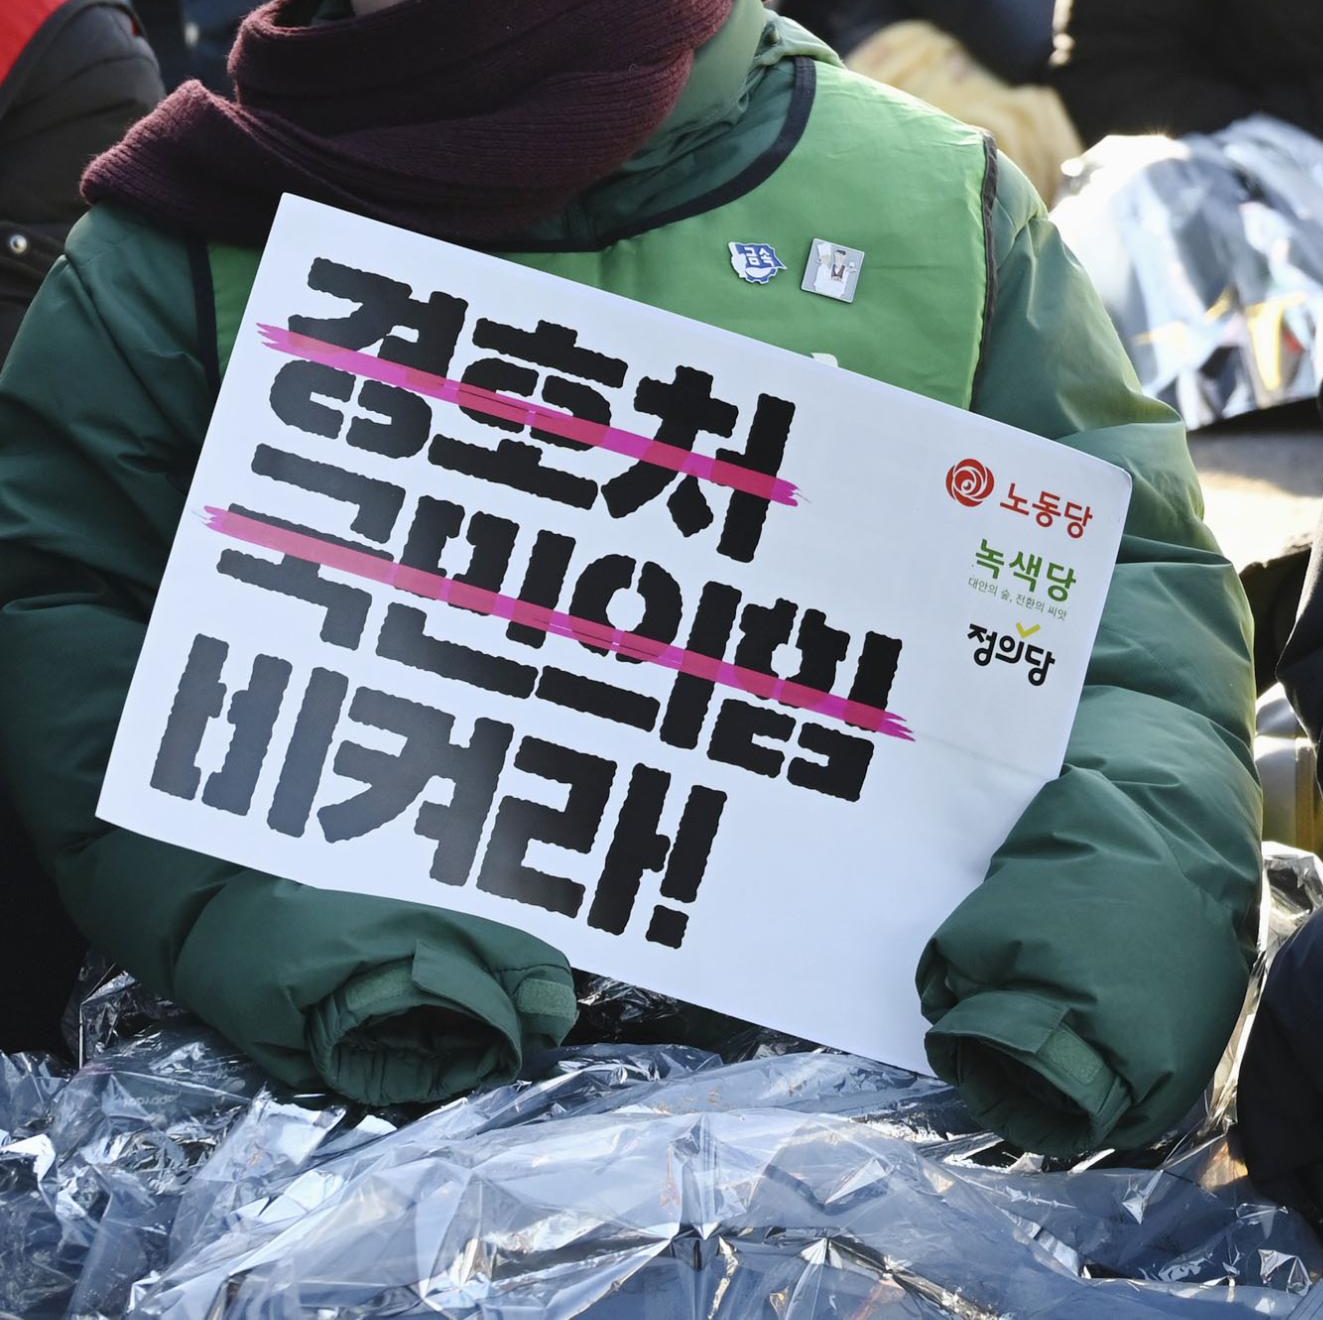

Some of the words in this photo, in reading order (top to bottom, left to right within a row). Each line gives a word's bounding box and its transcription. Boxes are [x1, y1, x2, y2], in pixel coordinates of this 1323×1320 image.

[744, 246, 775, 268] 금속
[269, 258, 795, 564] 경호처
[1000, 483, 1093, 538] 노동당
[968, 576, 997, 597] 대안의
[1015, 594, 1045, 613] 전환의
[975, 538, 1076, 602] 녹색당
[217, 443, 903, 803] 국민의힘
[967, 623, 1055, 686] 정의당
[151, 633, 728, 949] 비켜라!
